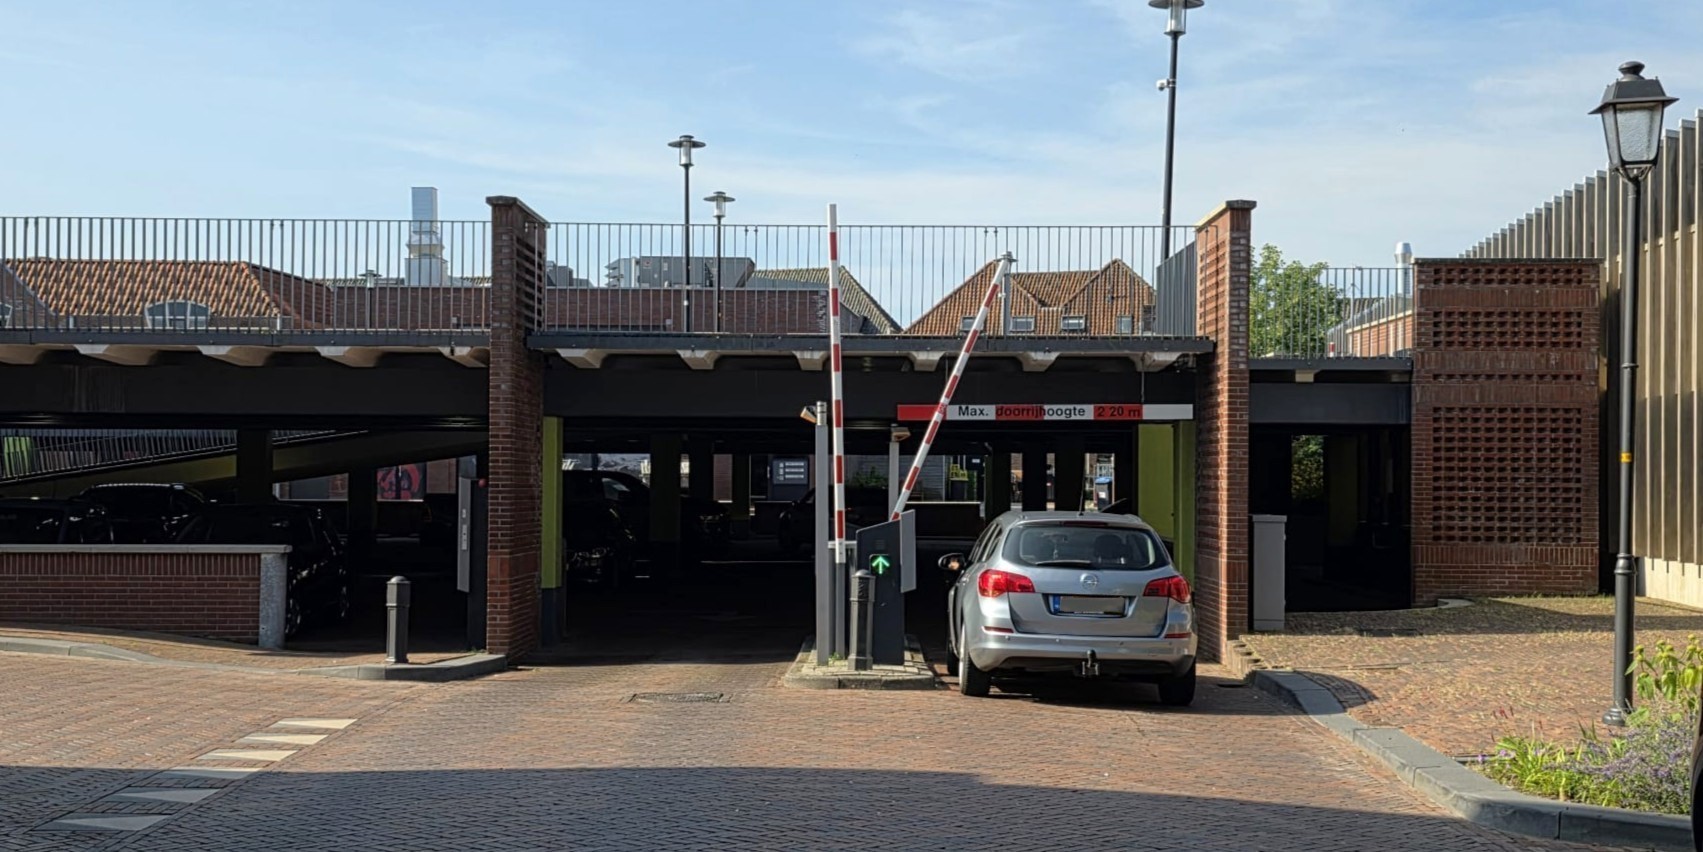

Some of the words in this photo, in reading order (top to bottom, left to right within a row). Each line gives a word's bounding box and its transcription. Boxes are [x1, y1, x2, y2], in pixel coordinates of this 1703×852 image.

[958, 405, 989, 417] Max.
[995, 405, 1086, 419] doorrijhoogte
[1128, 409, 1140, 417] m
